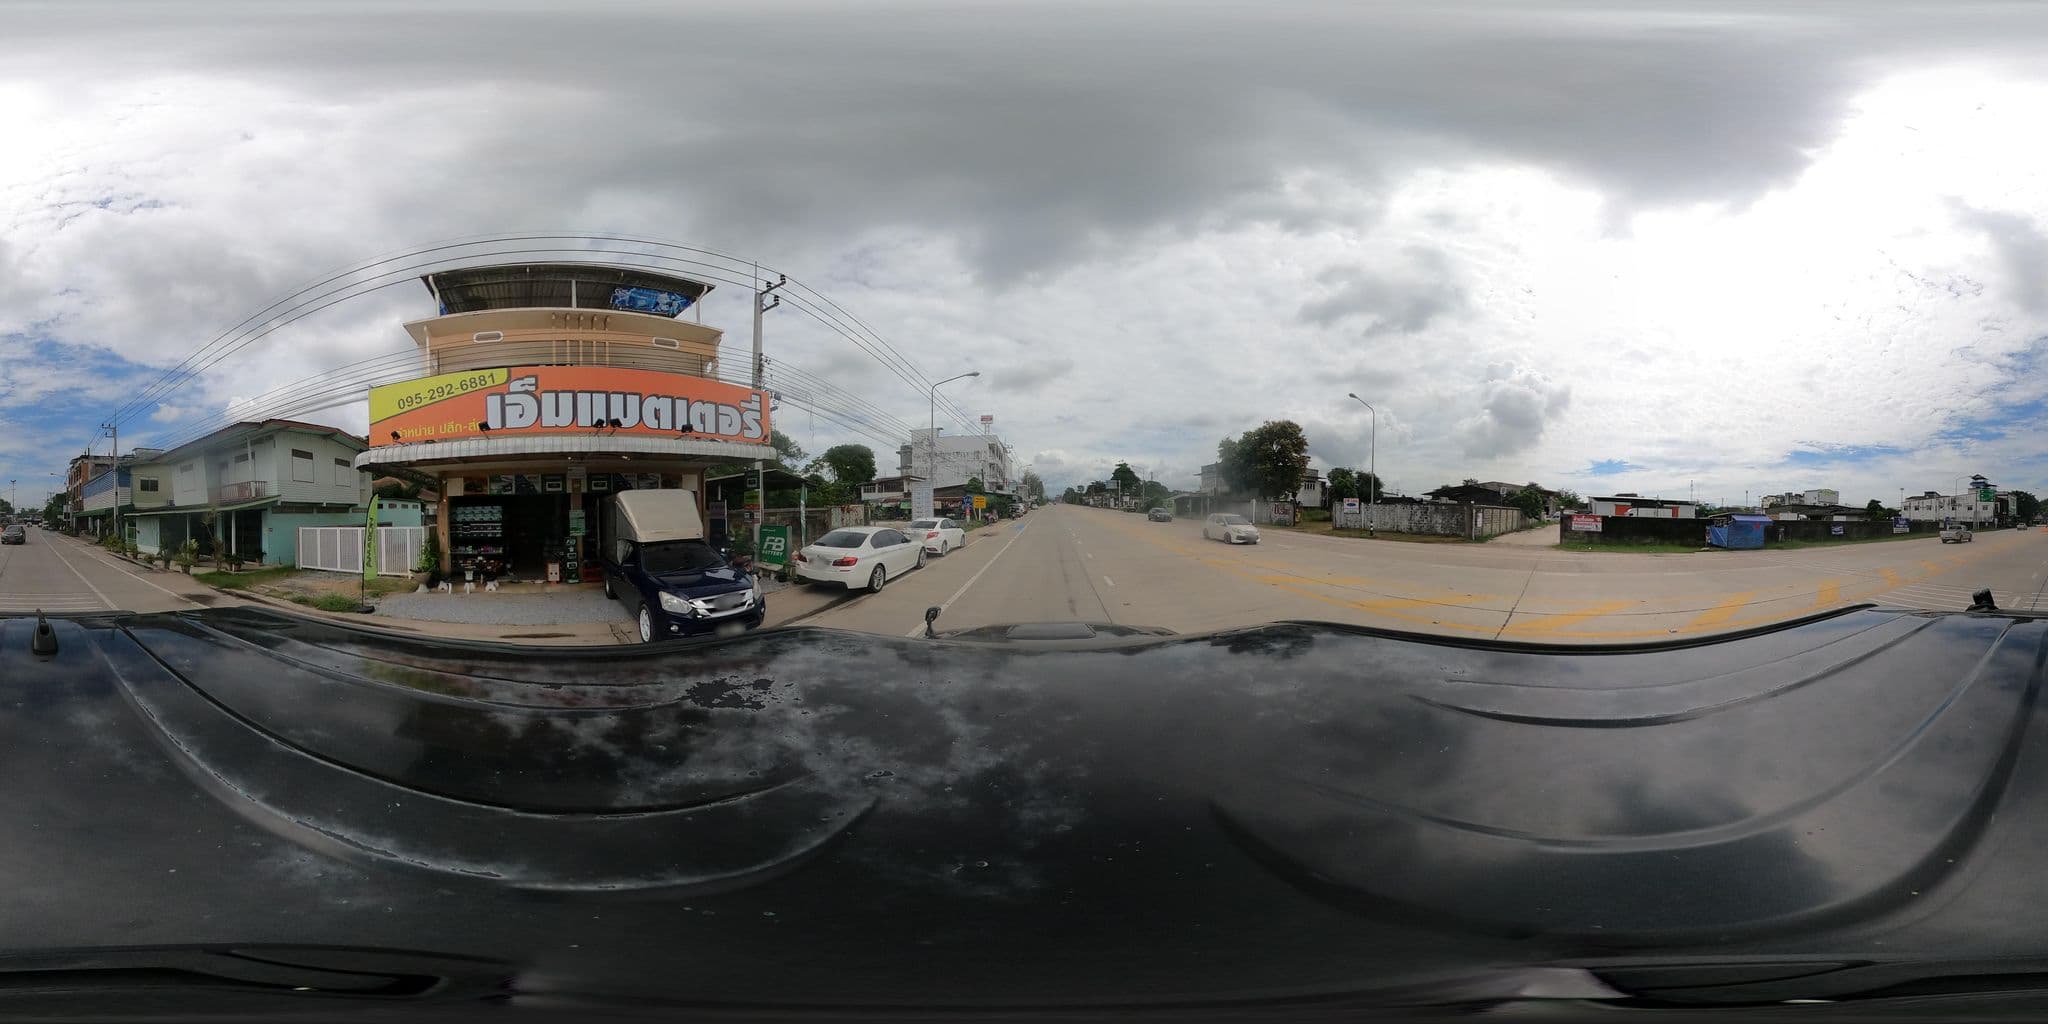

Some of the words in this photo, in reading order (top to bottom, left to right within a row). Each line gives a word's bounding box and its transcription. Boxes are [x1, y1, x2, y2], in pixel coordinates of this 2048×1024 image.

[397, 373, 496, 410] 095-292-6881
[486, 375, 763, 439] เอ็มแบตเตอรี่
[366, 518, 374, 567] AMARON
[763, 536, 785, 551] FB
